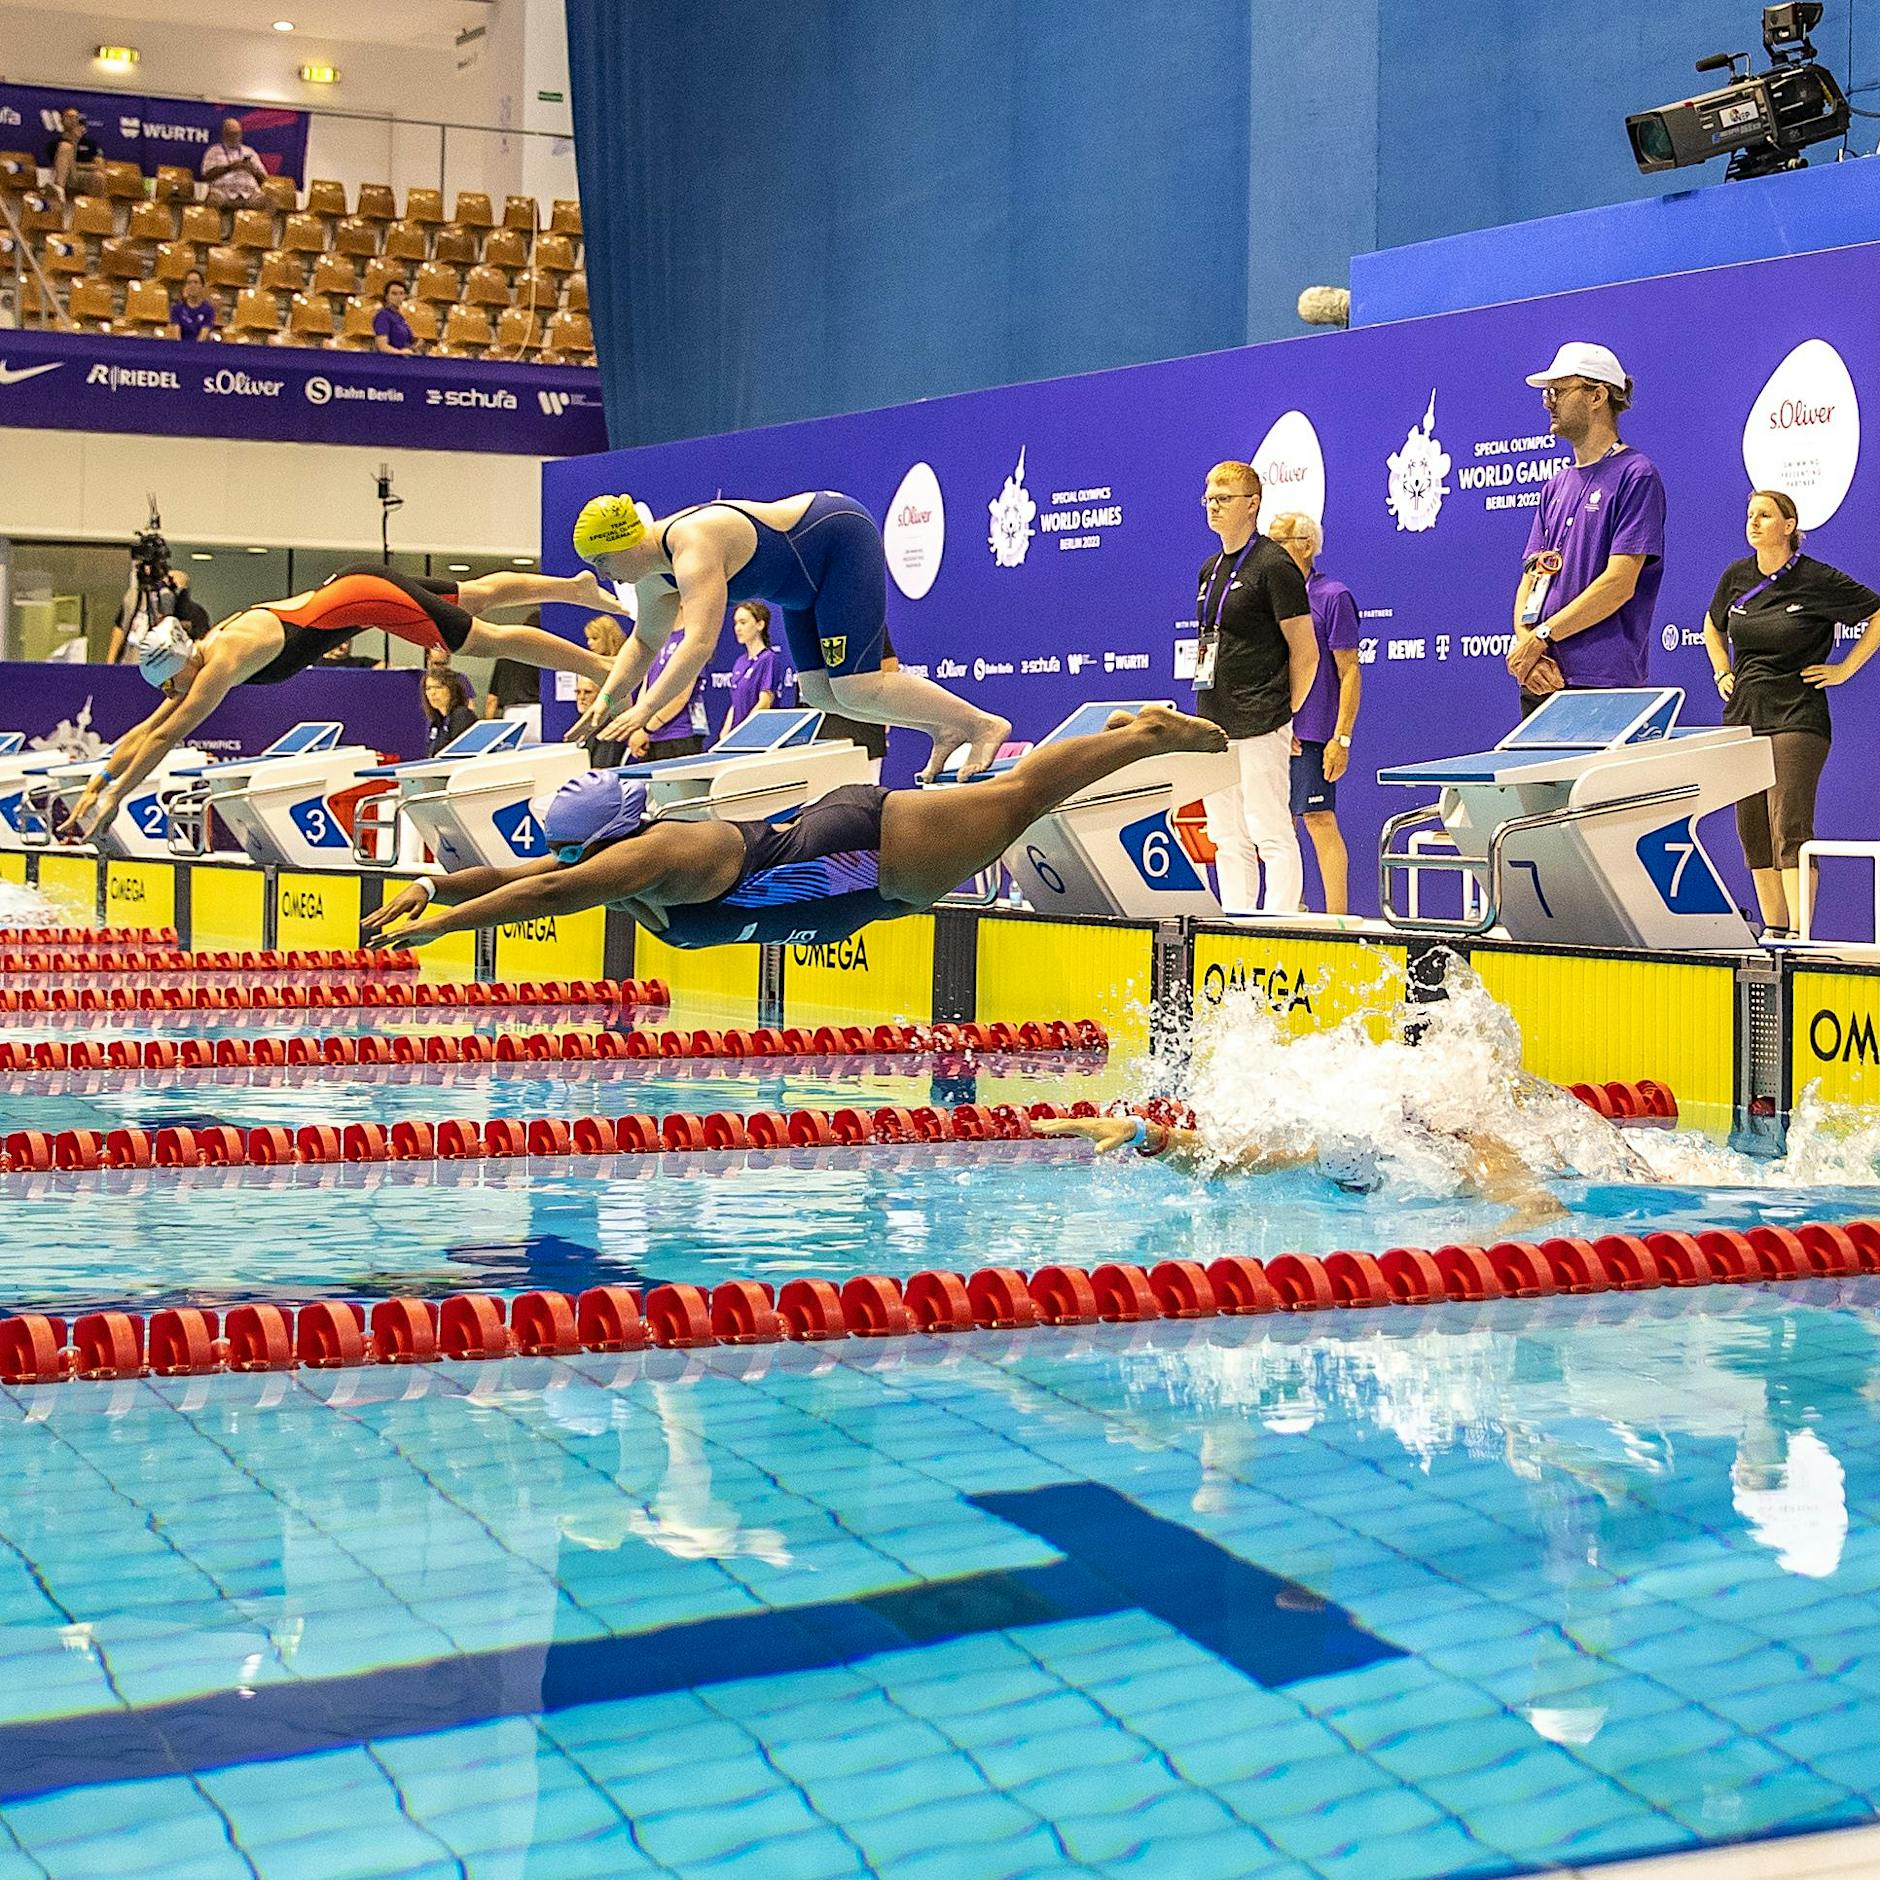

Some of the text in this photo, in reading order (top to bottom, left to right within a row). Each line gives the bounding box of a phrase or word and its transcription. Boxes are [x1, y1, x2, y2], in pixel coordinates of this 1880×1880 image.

[203, 369, 284, 397] s.Oliver
[367, 386, 404, 402] Berlin
[445, 388, 518, 409] schufa
[1770, 400, 1836, 430] s.Oliver
[1474, 434, 1556, 457] SPECIAL OLYMPICS
[1458, 456, 1572, 490] WORLD GAMES
[1051, 486, 1112, 505] SPECIAL OLYMPICS
[1485, 491, 1541, 511] BERLIN 2023
[1040, 505, 1123, 532] WORLD GAMES
[1059, 534, 1101, 550] BERLIN 2023
[1387, 638, 1426, 660] REWE
[142, 804, 164, 834] 2
[306, 808, 326, 843] 3
[511, 815, 535, 850] 4
[1026, 844, 1066, 895] 6
[1142, 830, 1170, 879] 6
[1664, 843, 1695, 898] 7
[1508, 860, 1554, 919] 7
[282, 890, 324, 920] OMEGA
[1809, 1008, 1880, 1066] OM
